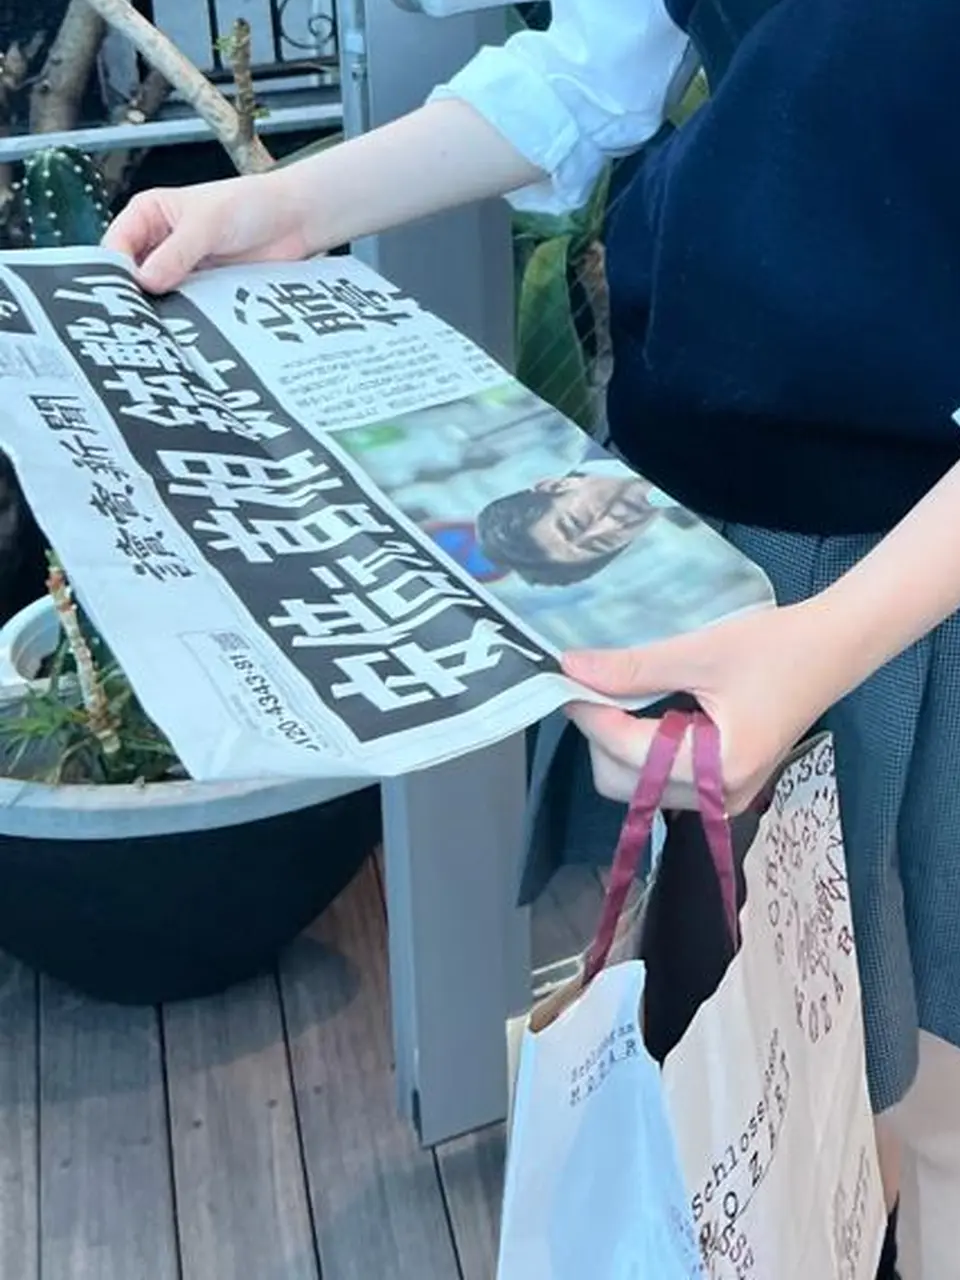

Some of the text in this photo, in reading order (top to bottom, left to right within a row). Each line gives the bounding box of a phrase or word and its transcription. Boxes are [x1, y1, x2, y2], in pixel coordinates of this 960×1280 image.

[157, 447, 544, 711] 安倍元首相
